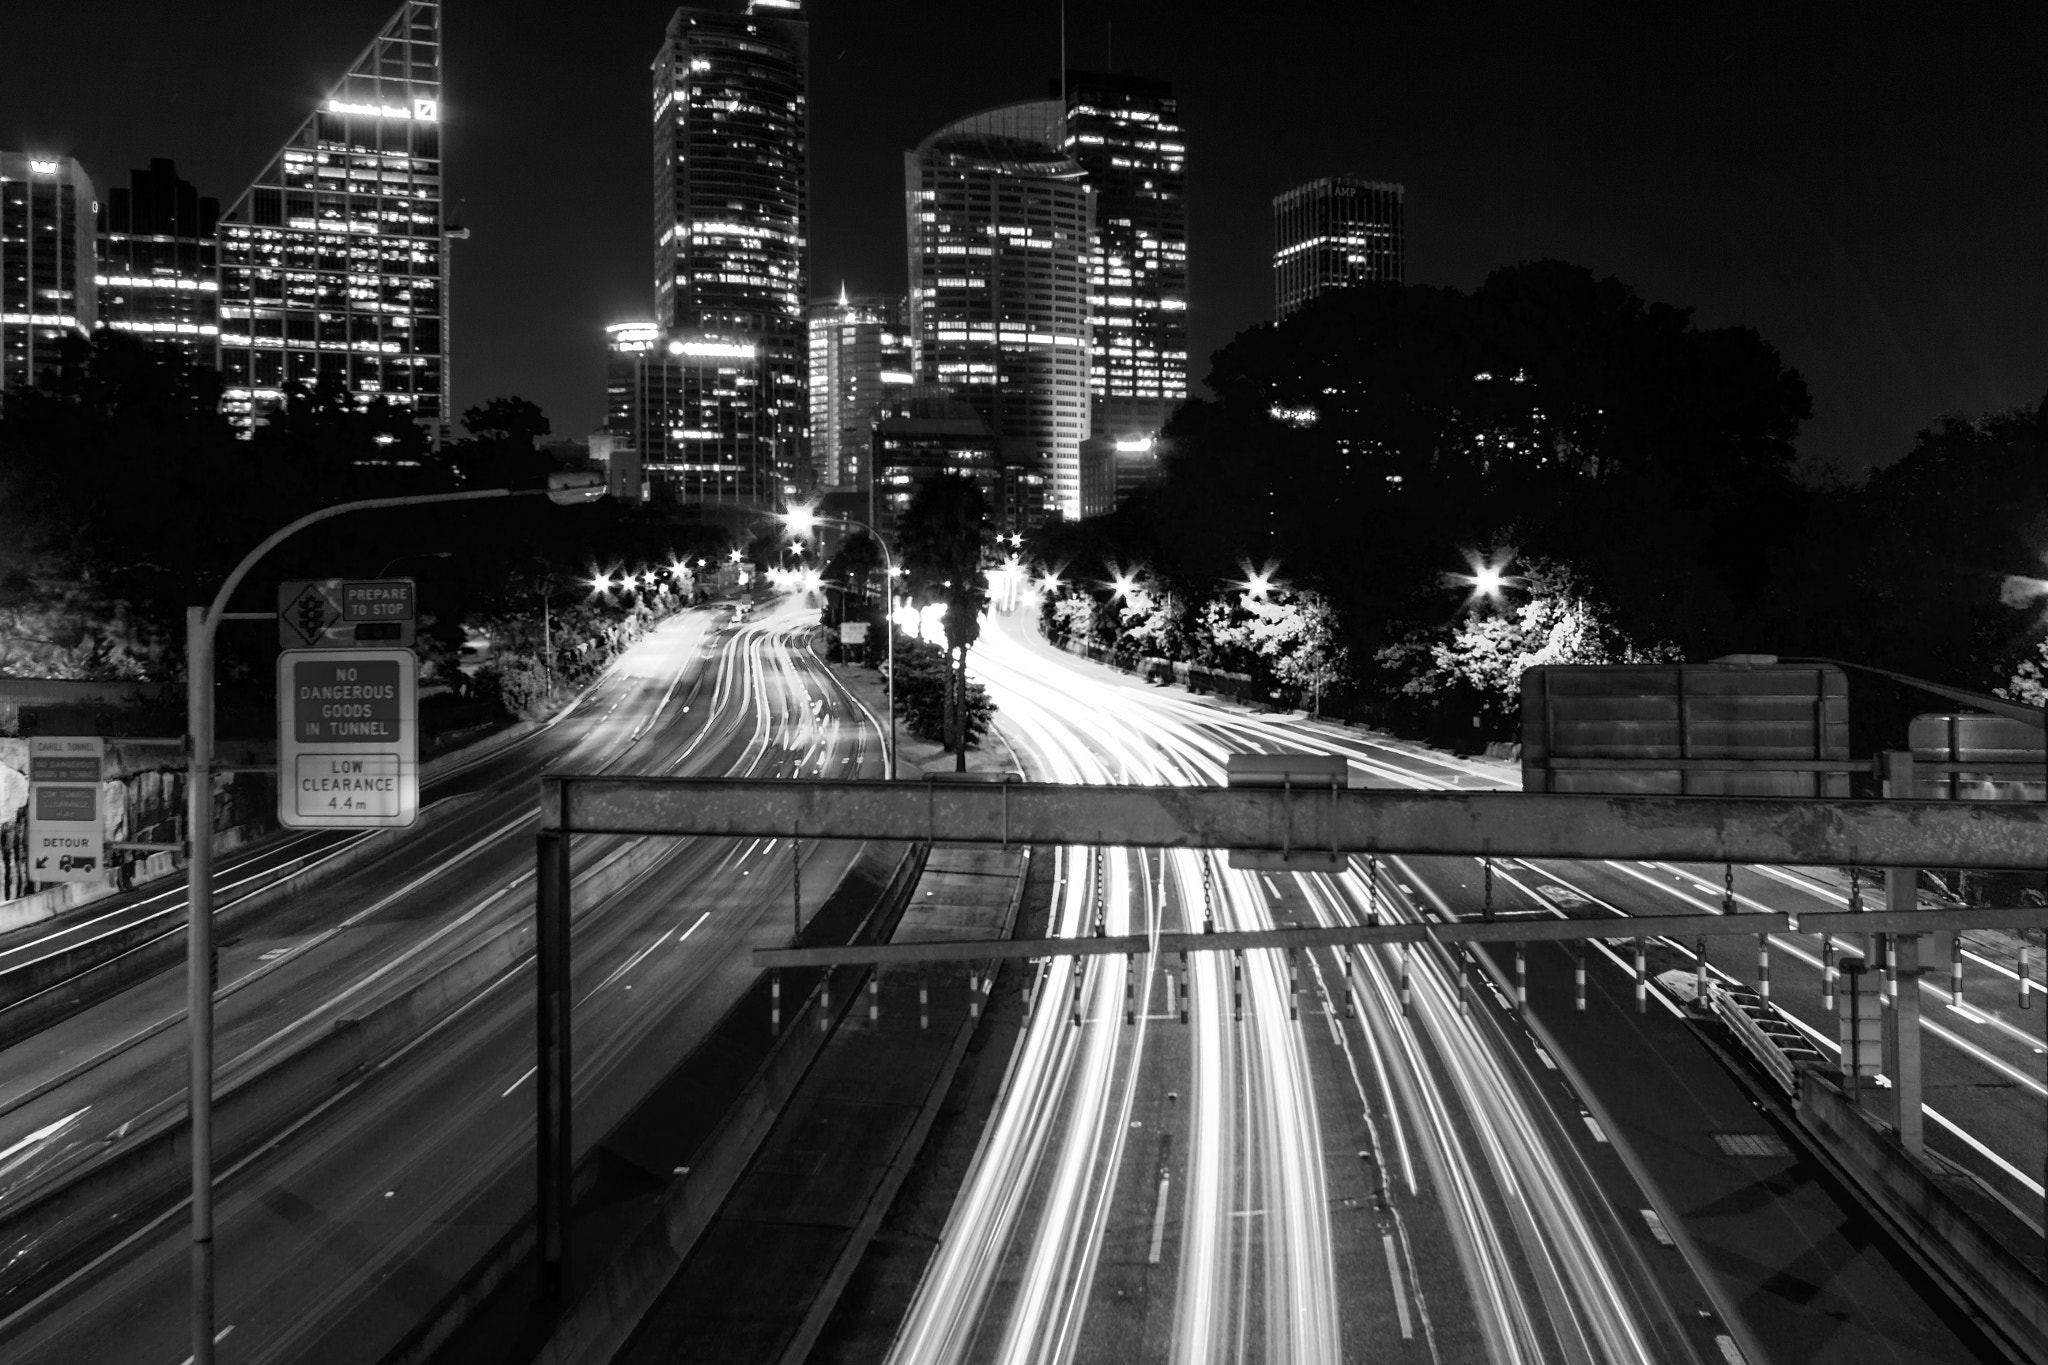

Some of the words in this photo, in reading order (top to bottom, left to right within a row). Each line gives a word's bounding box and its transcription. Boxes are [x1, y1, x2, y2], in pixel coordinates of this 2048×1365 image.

[1334, 186, 1356, 197] AMP
[349, 588, 408, 600] PREPARE
[352, 604, 367, 615] TO
[373, 603, 404, 615] STOP
[336, 668, 358, 681] NO
[301, 685, 394, 699] DANGEROUS
[322, 704, 372, 718] GOODS
[305, 723, 320, 735] IN
[330, 722, 389, 735] TUNNEL
[38, 743, 63, 751] CAHILL
[67, 743, 95, 751] TUNNEL
[332, 761, 363, 773] LOW
[302, 779, 393, 791] CLEARANCE
[43, 838, 89, 847] DETOUR
